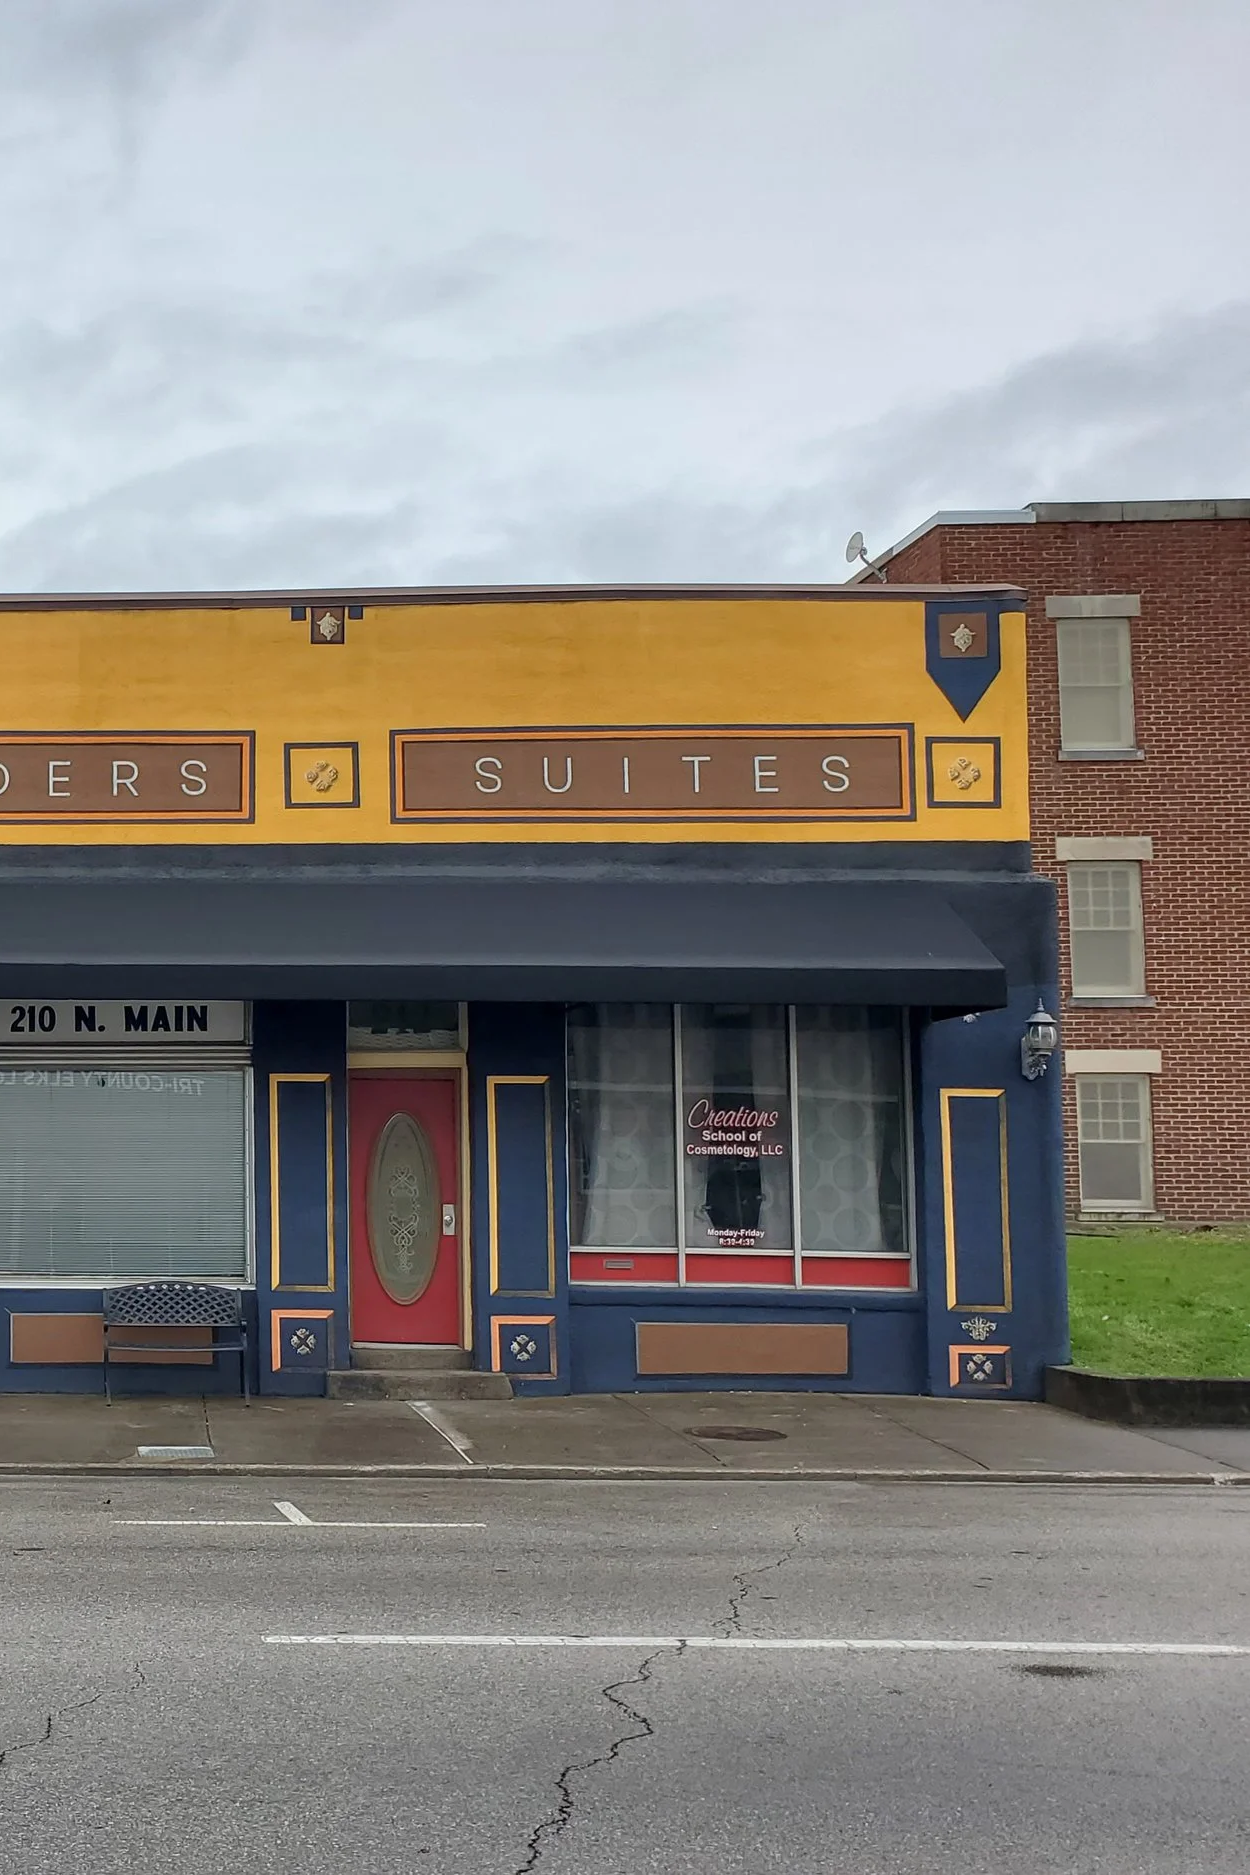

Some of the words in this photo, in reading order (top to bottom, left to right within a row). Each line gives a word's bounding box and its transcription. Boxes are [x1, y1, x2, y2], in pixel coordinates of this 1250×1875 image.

[474, 755, 850, 793] SUITES
[10, 1005, 56, 1032] 210
[74, 1005, 106, 1032] N.
[124, 1005, 208, 1032] MAIN
[687, 1099, 779, 1128] Creations
[702, 1130, 746, 1141] School
[749, 1130, 763, 1141] of
[686, 1144, 759, 1158] Cosmetology,
[761, 1145, 783, 1155] LLC
[707, 1228, 765, 1239] Monday-Friday
